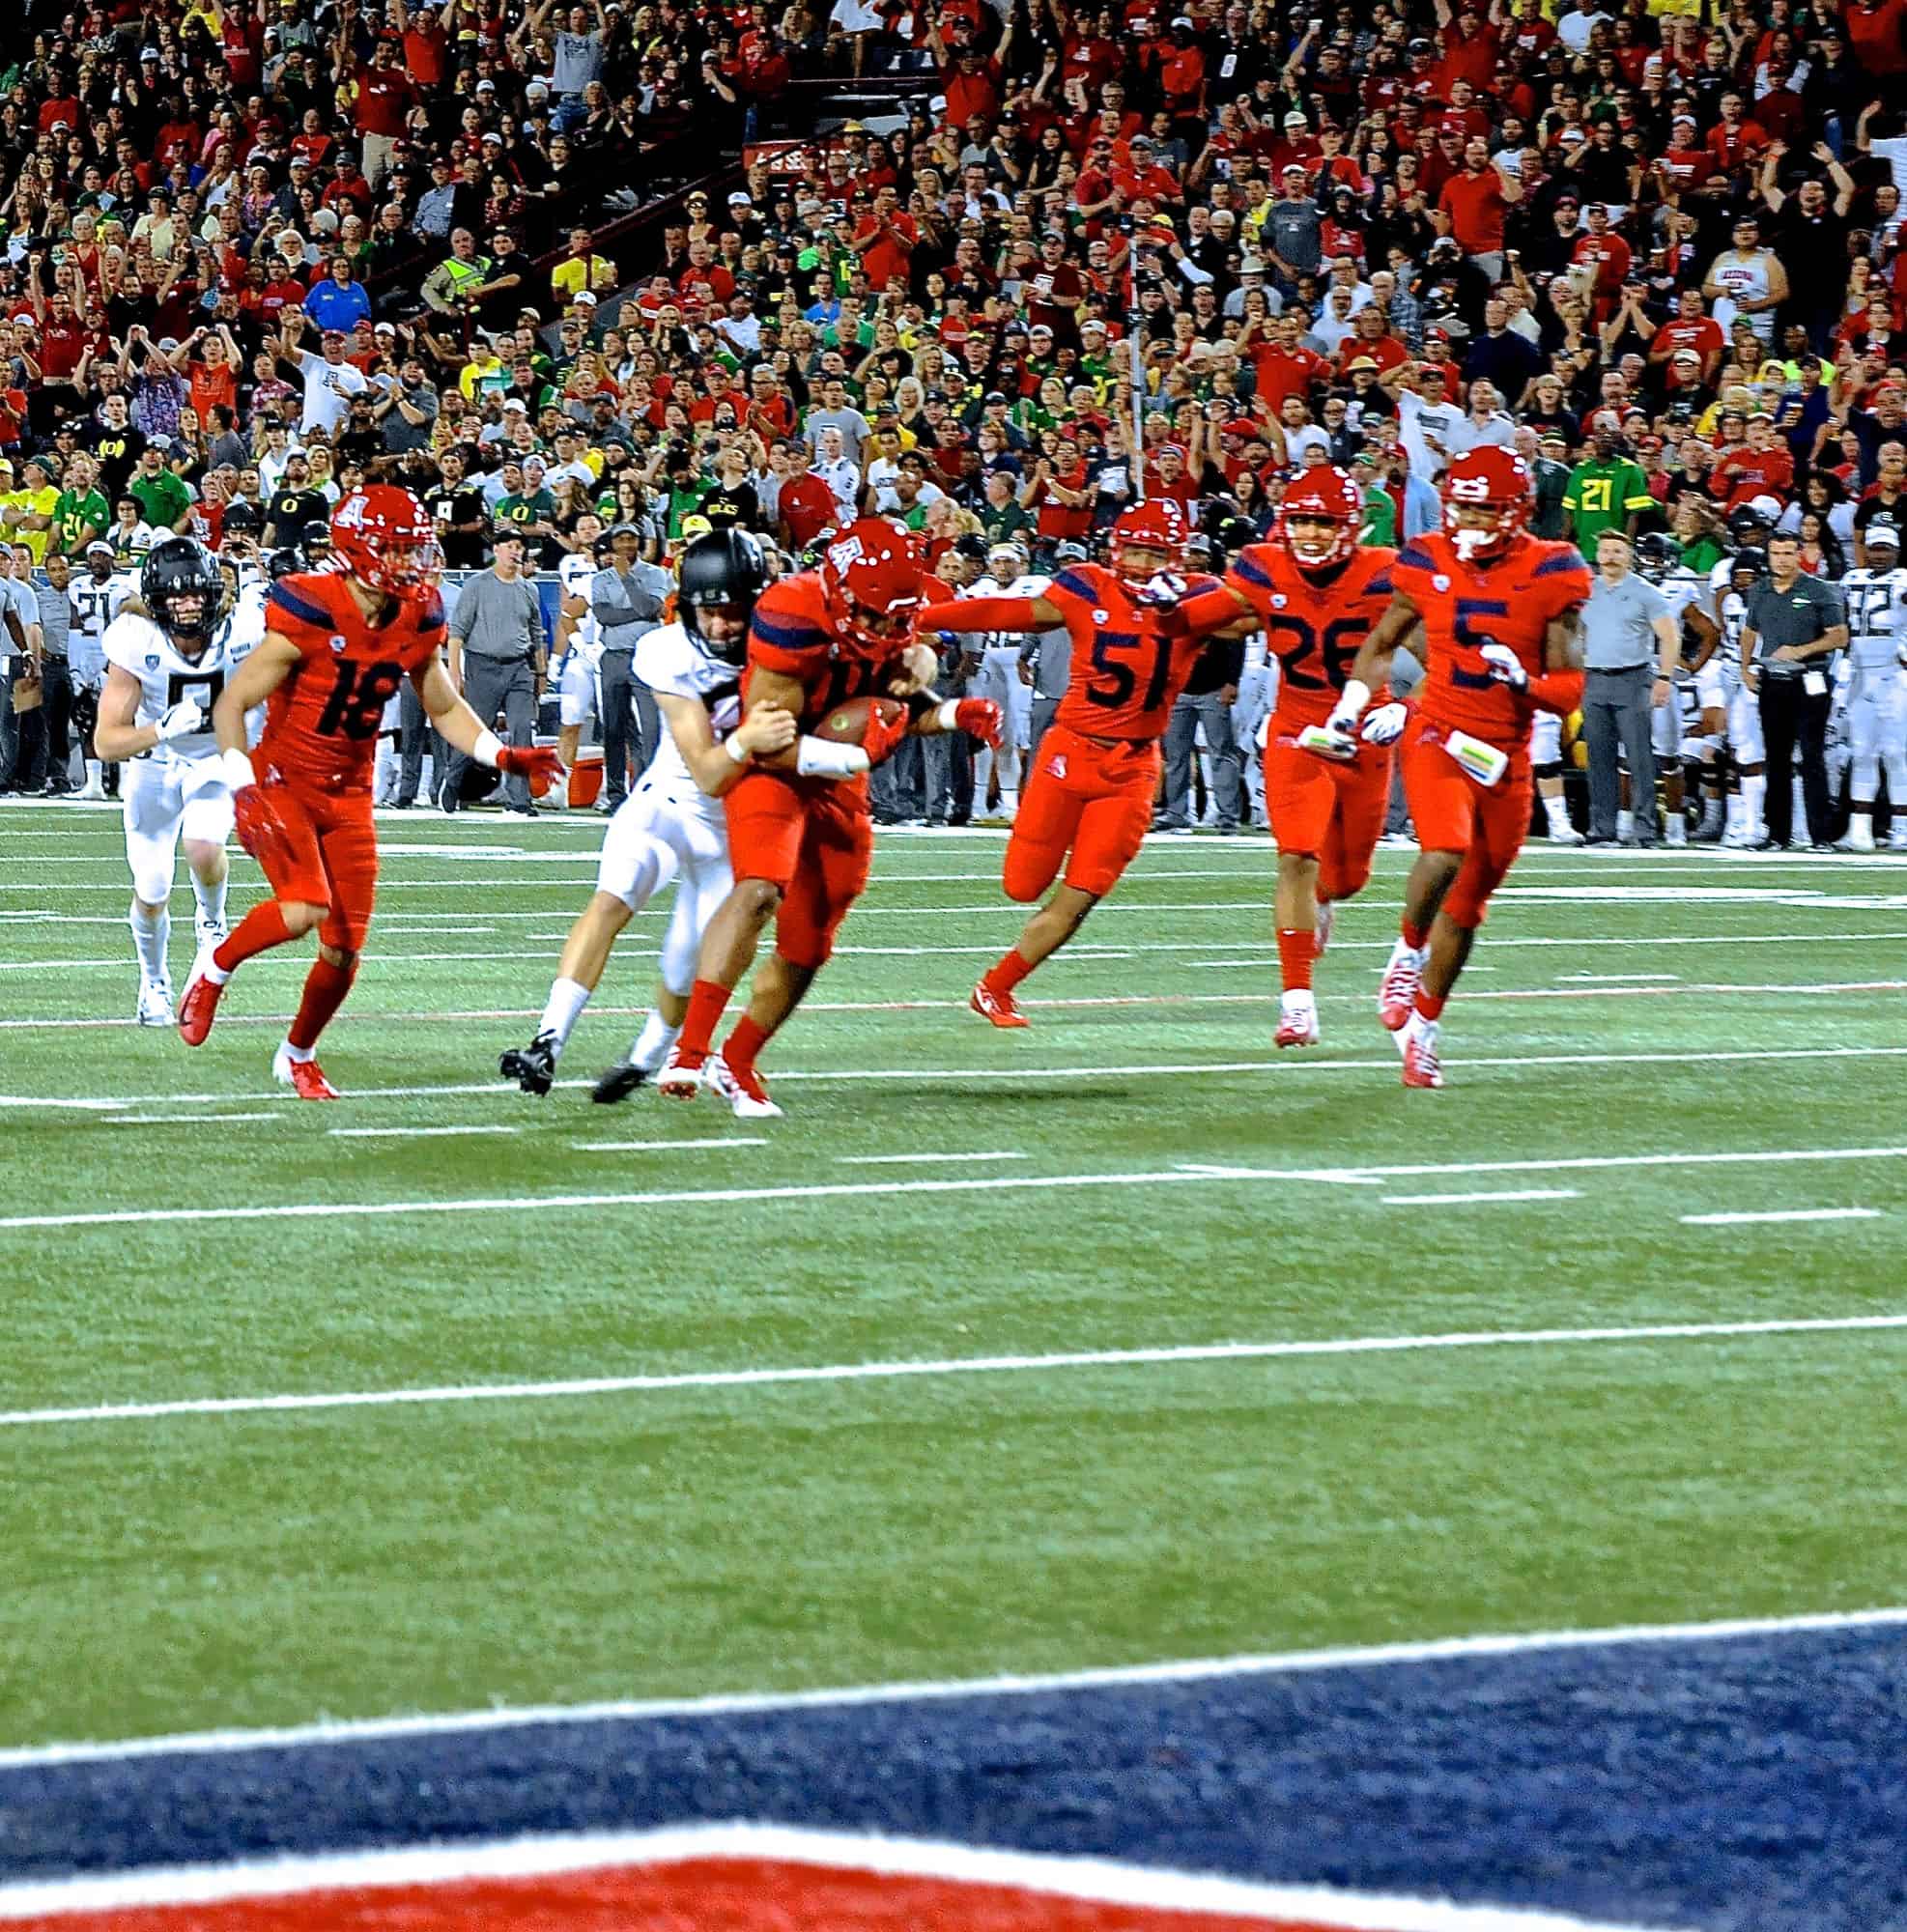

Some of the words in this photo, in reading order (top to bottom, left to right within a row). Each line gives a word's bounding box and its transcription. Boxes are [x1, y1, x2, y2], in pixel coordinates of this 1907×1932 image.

[281, 498, 298, 513] O
[512, 505, 529, 522] O
[1581, 478, 1612, 511] 21
[1087, 630, 1173, 712] 51
[1269, 614, 1371, 692] 26
[1452, 598, 1510, 690] 5
[317, 659, 404, 739] 18
